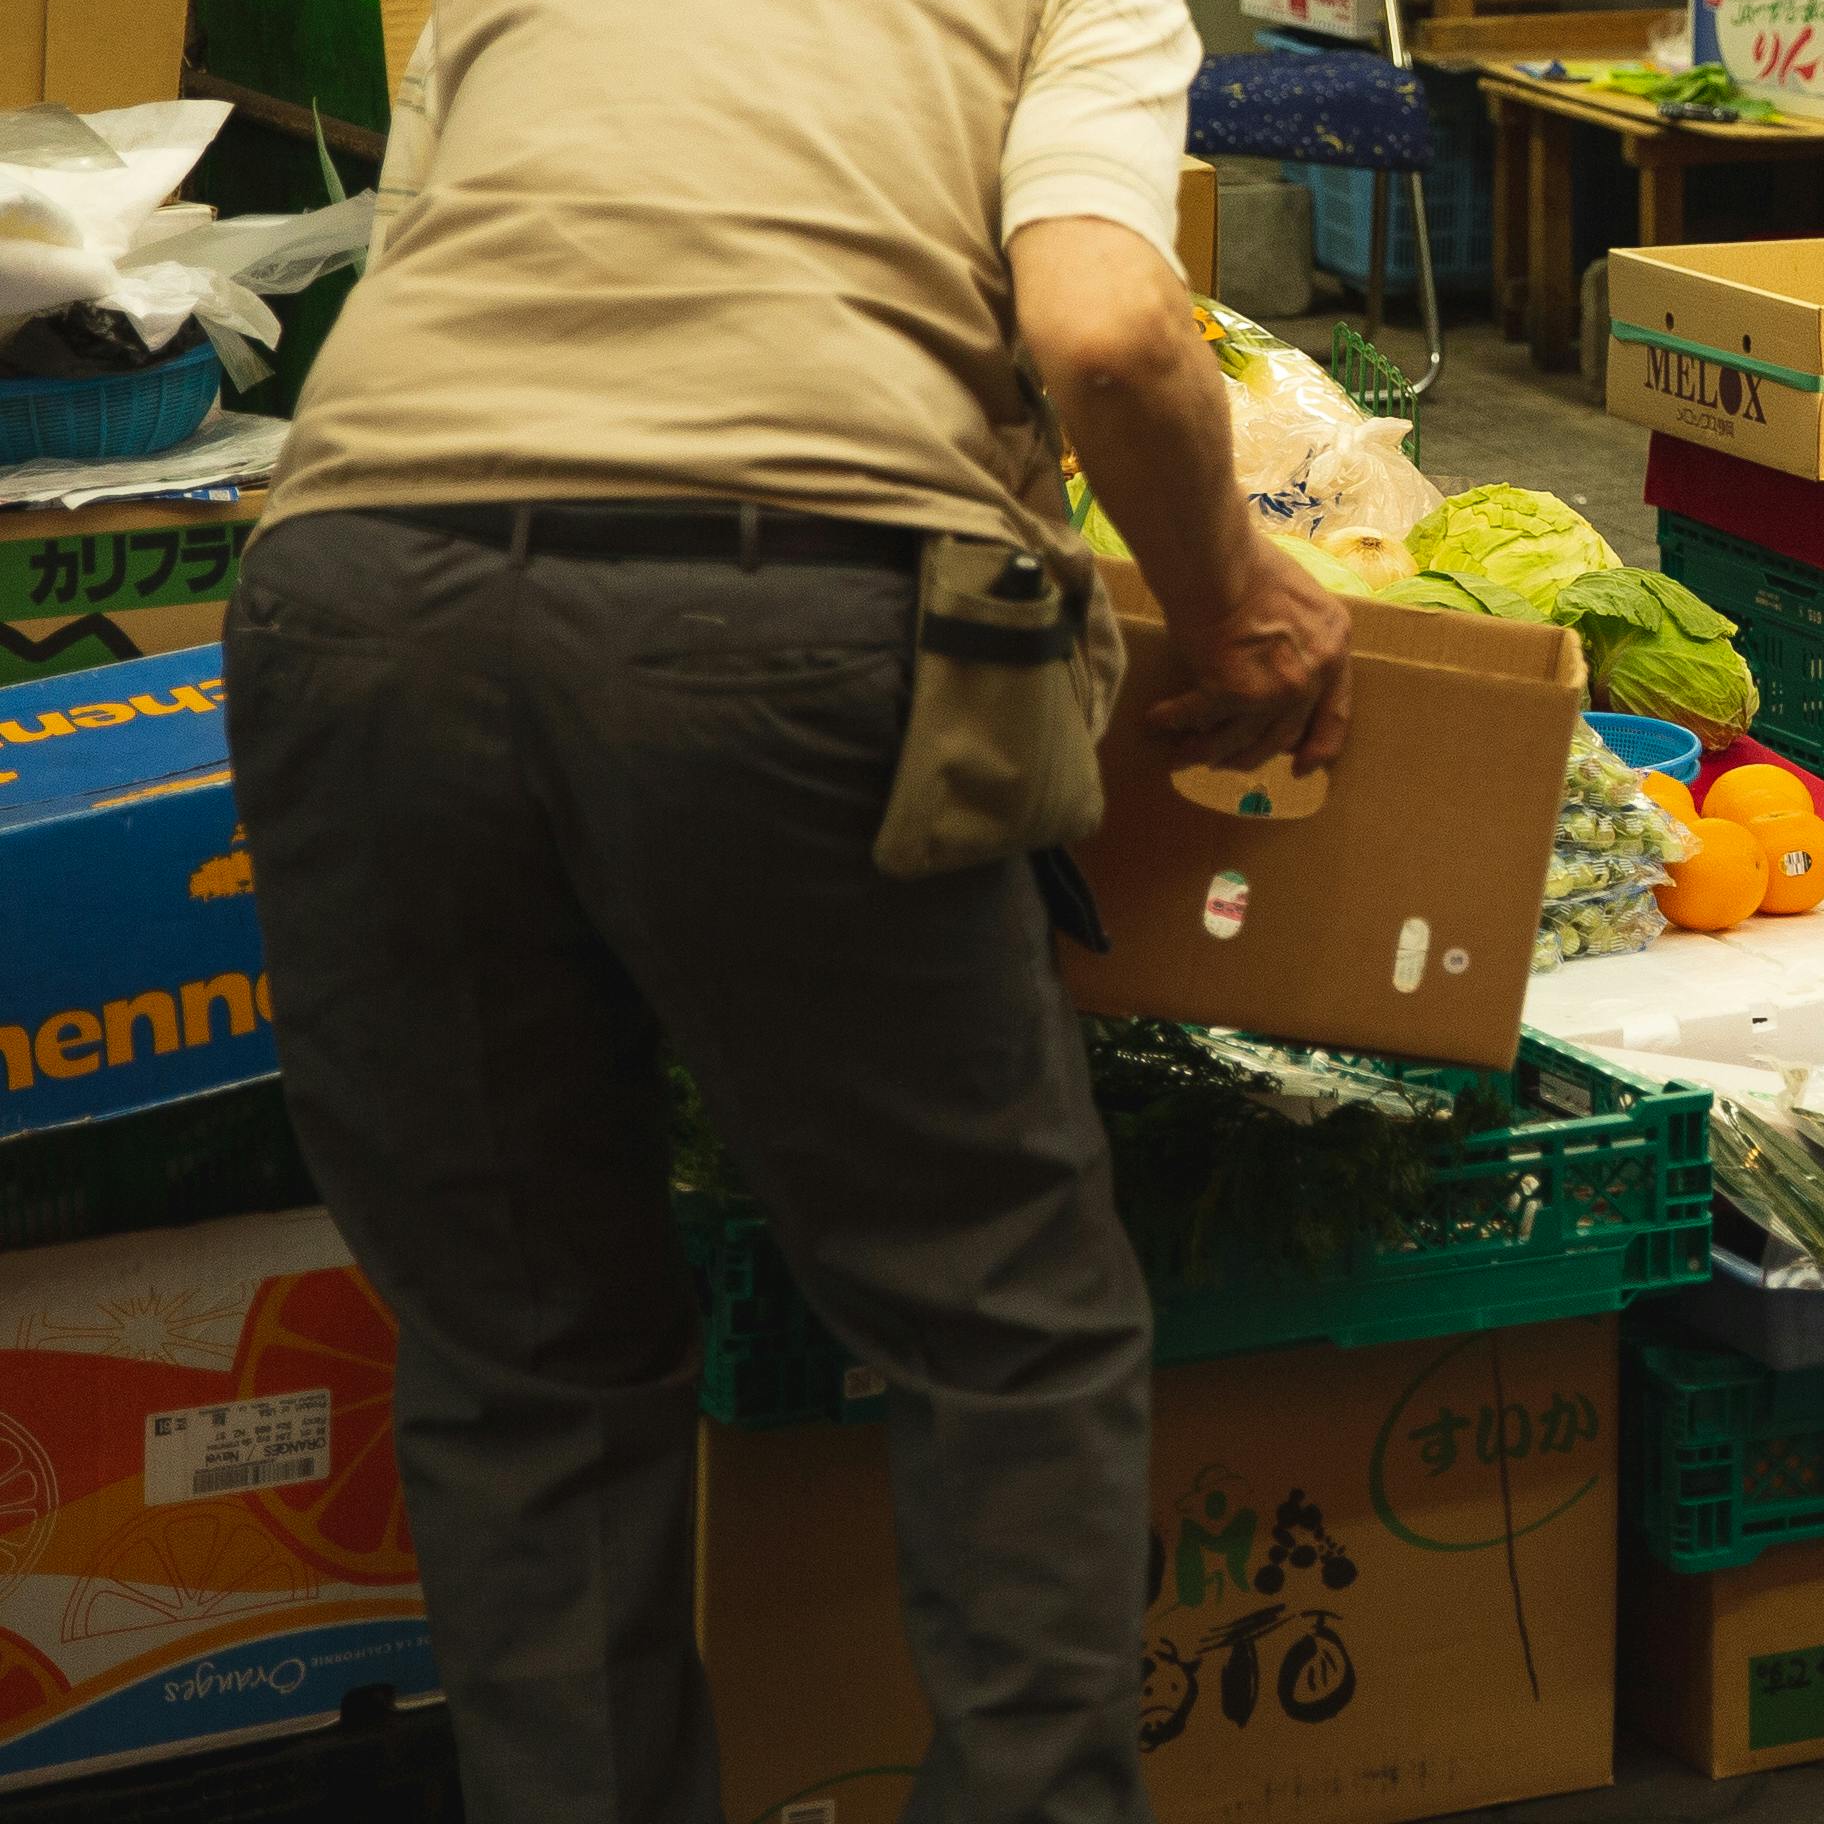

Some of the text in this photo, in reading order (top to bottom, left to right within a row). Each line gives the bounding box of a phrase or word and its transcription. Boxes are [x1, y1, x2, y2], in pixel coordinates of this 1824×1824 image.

[30, 525, 246, 606] カリフラ
[263, 1436, 327, 1458] ORANGES
[1408, 1392, 1599, 1479] すいか
[205, 1449, 240, 1467] Navel
[310, 1642, 393, 1667] CALIFORNIE
[163, 1658, 307, 1704] Oranges
